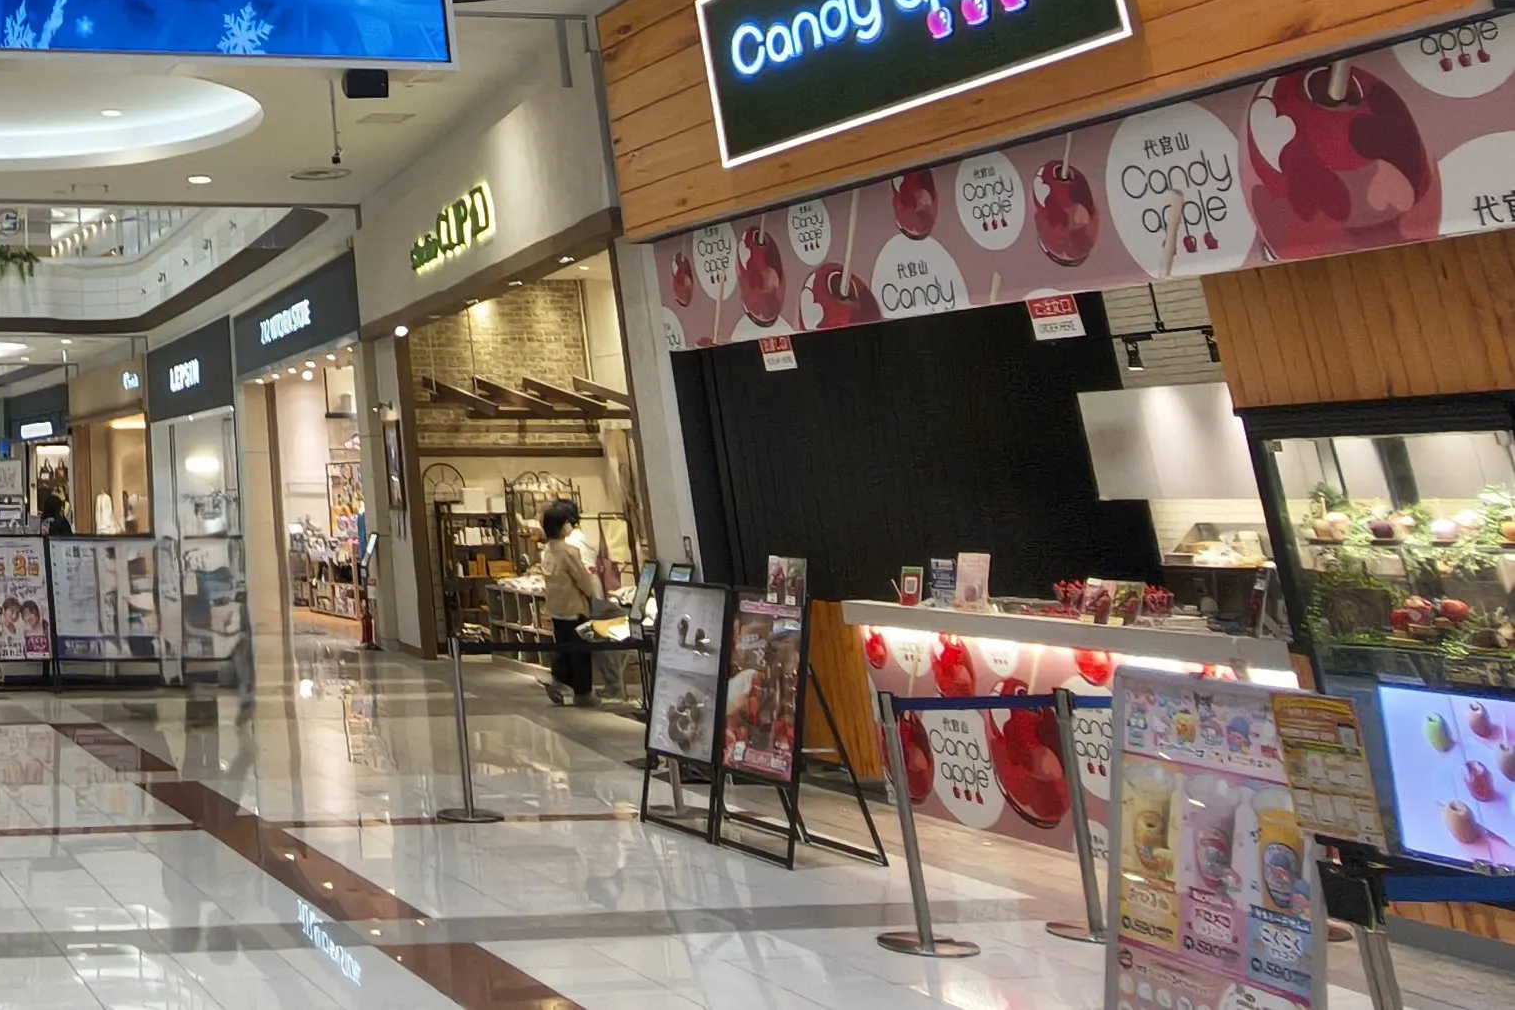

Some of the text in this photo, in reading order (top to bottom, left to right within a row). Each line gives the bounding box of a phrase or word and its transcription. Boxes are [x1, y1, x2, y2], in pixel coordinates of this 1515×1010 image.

[1419, 17, 1499, 58] apple
[1142, 132, 1191, 160] 代官山
[962, 175, 1014, 202] Candy
[1121, 149, 1234, 200] Candy
[972, 196, 1012, 221] apple
[896, 259, 930, 280] 代官山
[881, 275, 956, 314] Candy
[928, 728, 992, 772] Candy
[940, 762, 991, 792] apple
